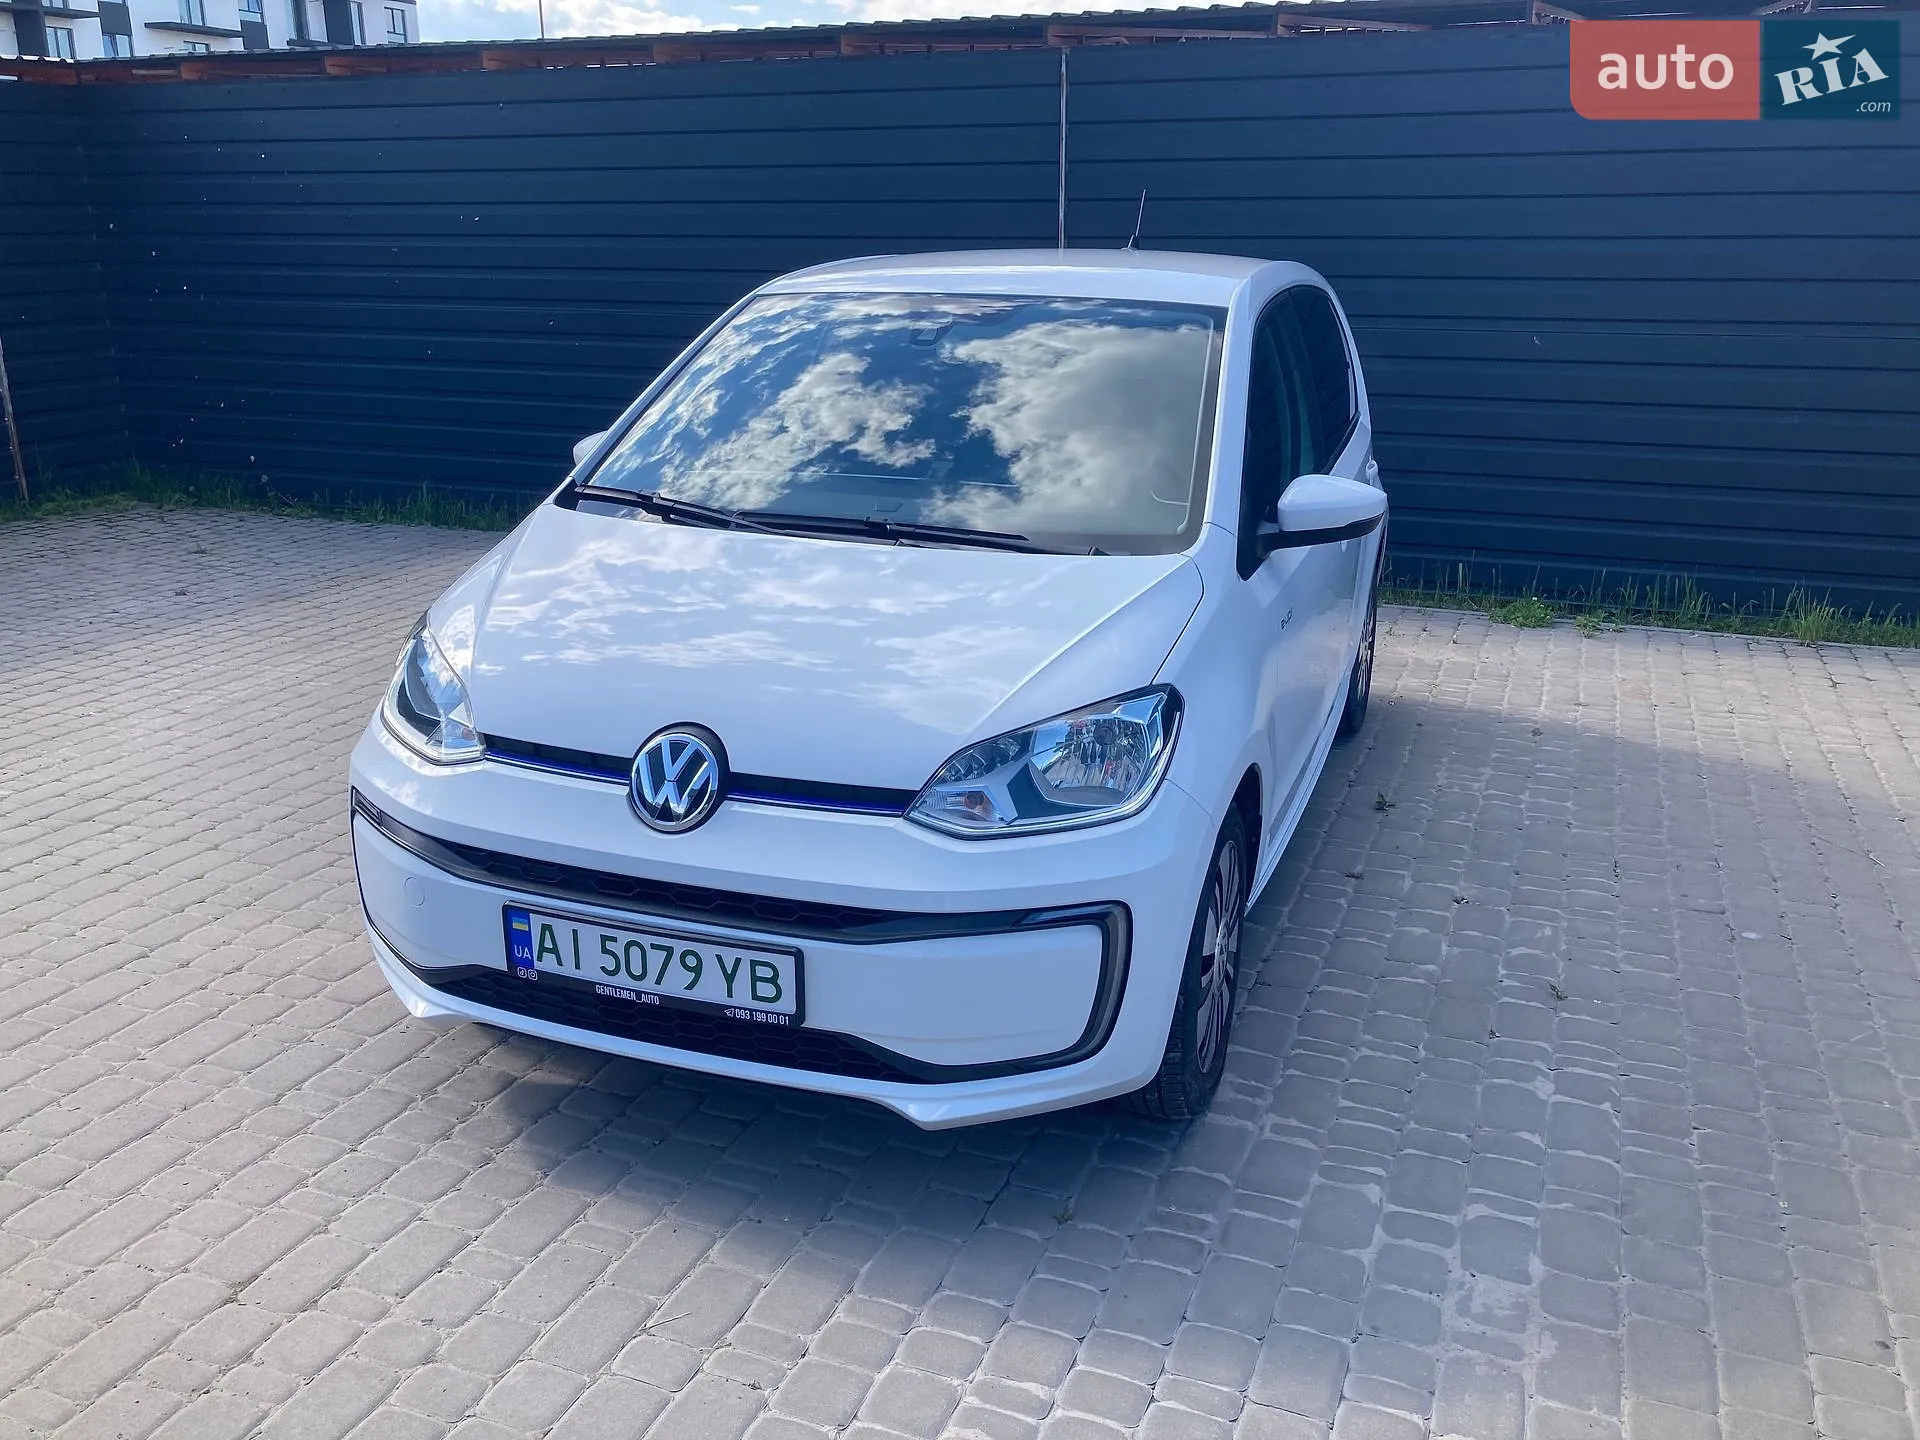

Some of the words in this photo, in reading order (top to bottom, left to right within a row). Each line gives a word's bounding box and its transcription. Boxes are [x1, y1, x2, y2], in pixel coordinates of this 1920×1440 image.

[633, 735, 718, 827] VW
[514, 945, 532, 960] UA
[536, 923, 581, 970] AI
[599, 934, 703, 990] 5079
[715, 953, 782, 1003] YB
[595, 984, 660, 1005] GENTLEMEN_AUTO
[735, 1008, 750, 1020] 093
[752, 1011, 767, 1022] 199
[767, 1013, 778, 1024] 00
[779, 1015, 789, 1026] 01
